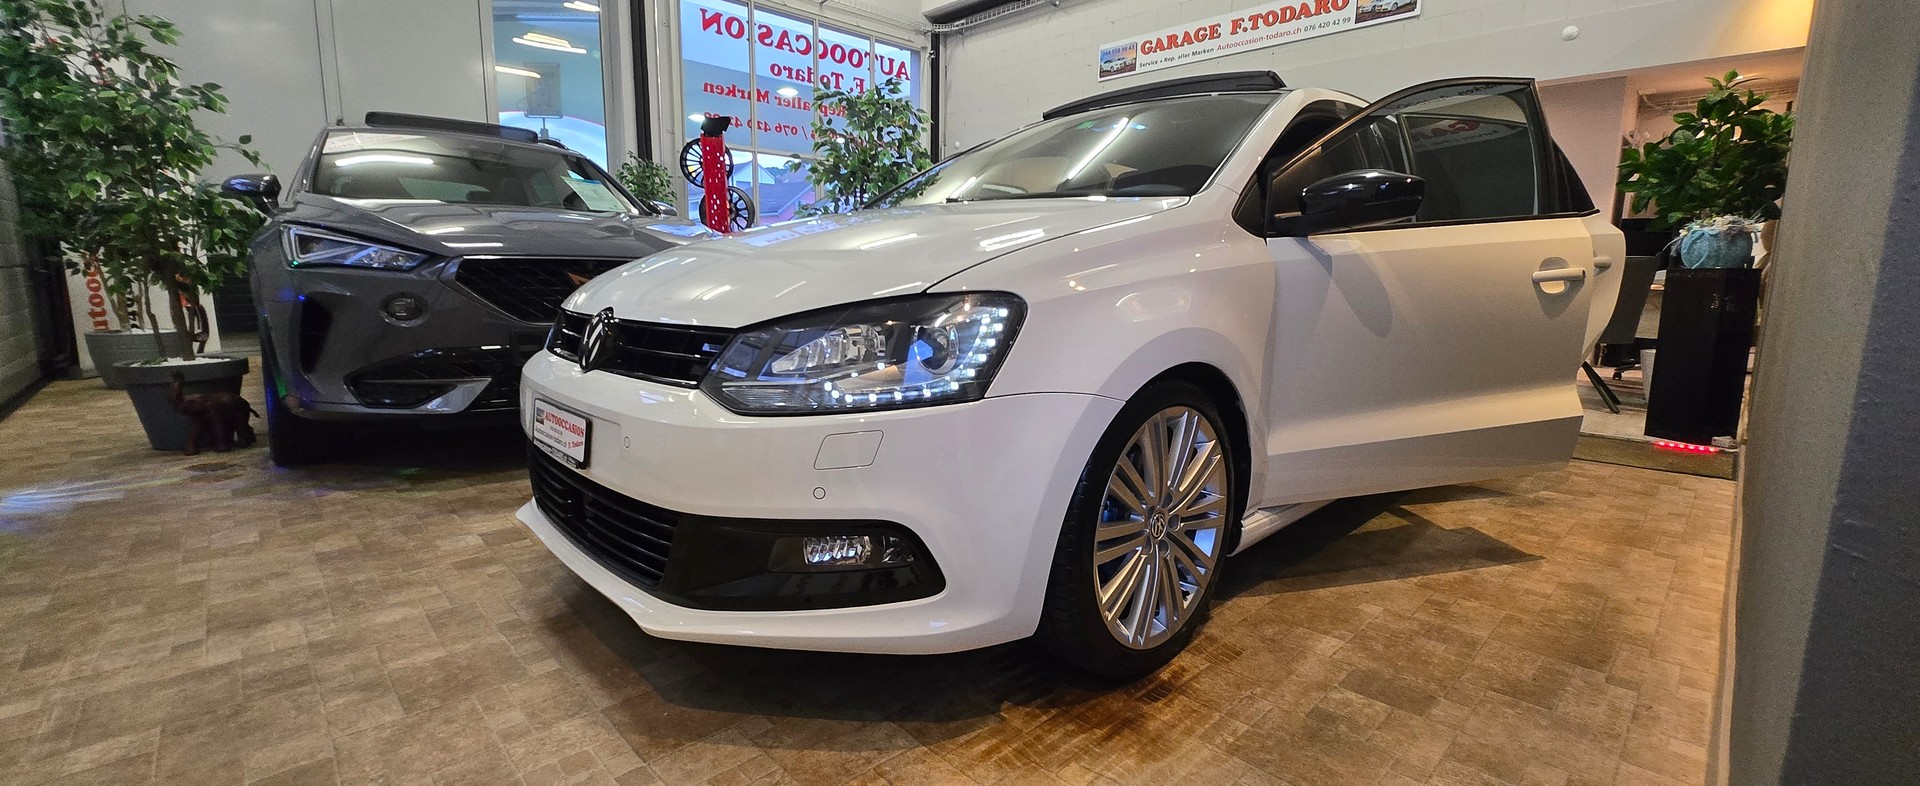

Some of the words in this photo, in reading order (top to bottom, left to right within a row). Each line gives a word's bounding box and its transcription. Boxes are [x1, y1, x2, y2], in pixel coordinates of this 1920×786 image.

[1140, 23, 1222, 56] GARAGE
[1192, 48, 1214, 56] Marken
[1216, 27, 1302, 51] Autooccasion-todaro.ch
[1304, 24, 1316, 32] 076
[1318, 21, 1330, 29] 420
[1343, 16, 1351, 24] 99
[545, 411, 585, 437] AUTOOCCASION
